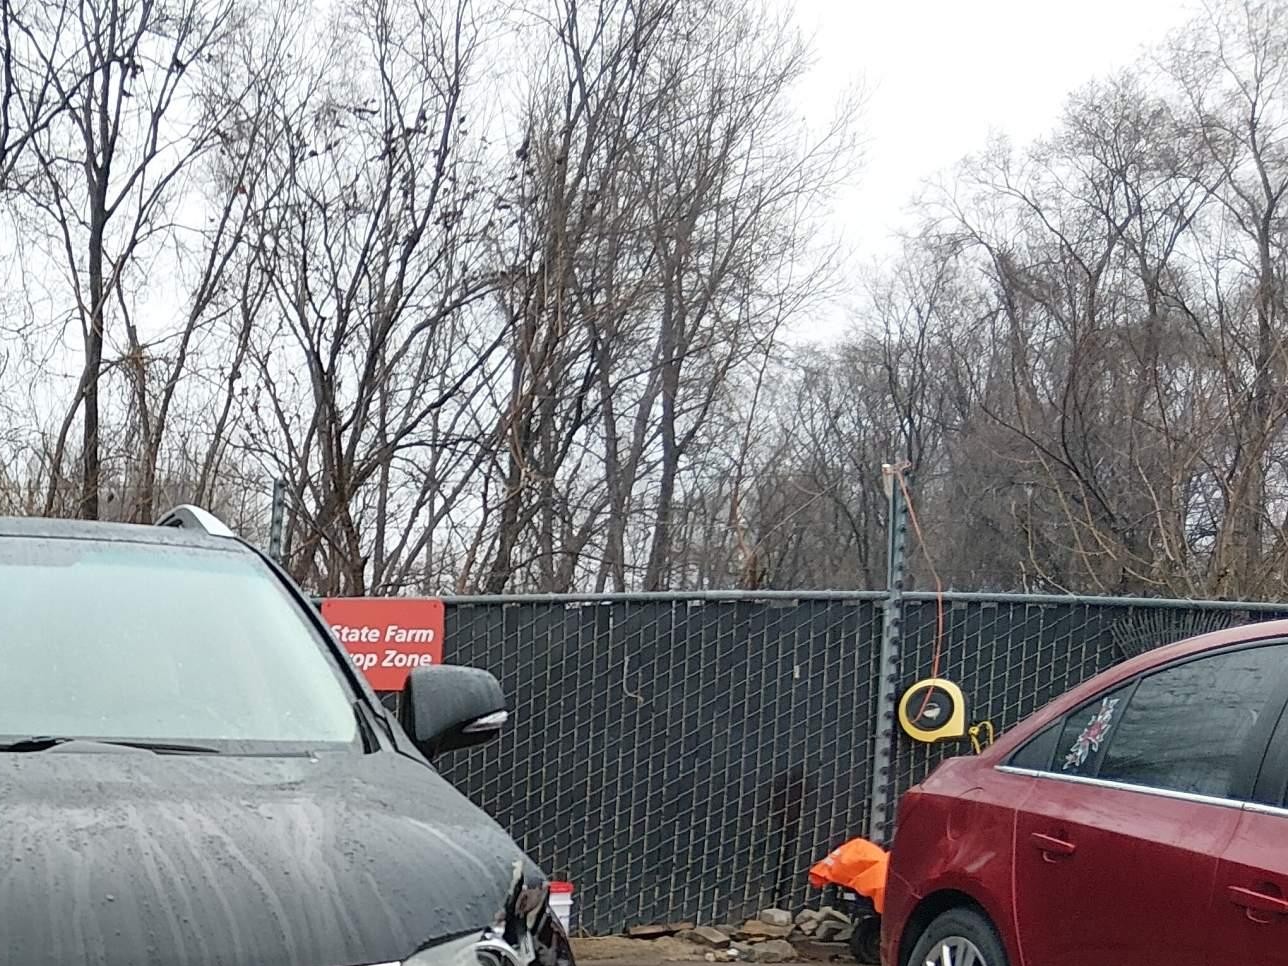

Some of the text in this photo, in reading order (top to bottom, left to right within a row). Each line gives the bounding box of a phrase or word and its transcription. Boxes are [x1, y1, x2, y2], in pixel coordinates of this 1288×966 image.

[329, 624, 434, 643] State Farm
[381, 649, 433, 667] Zone
